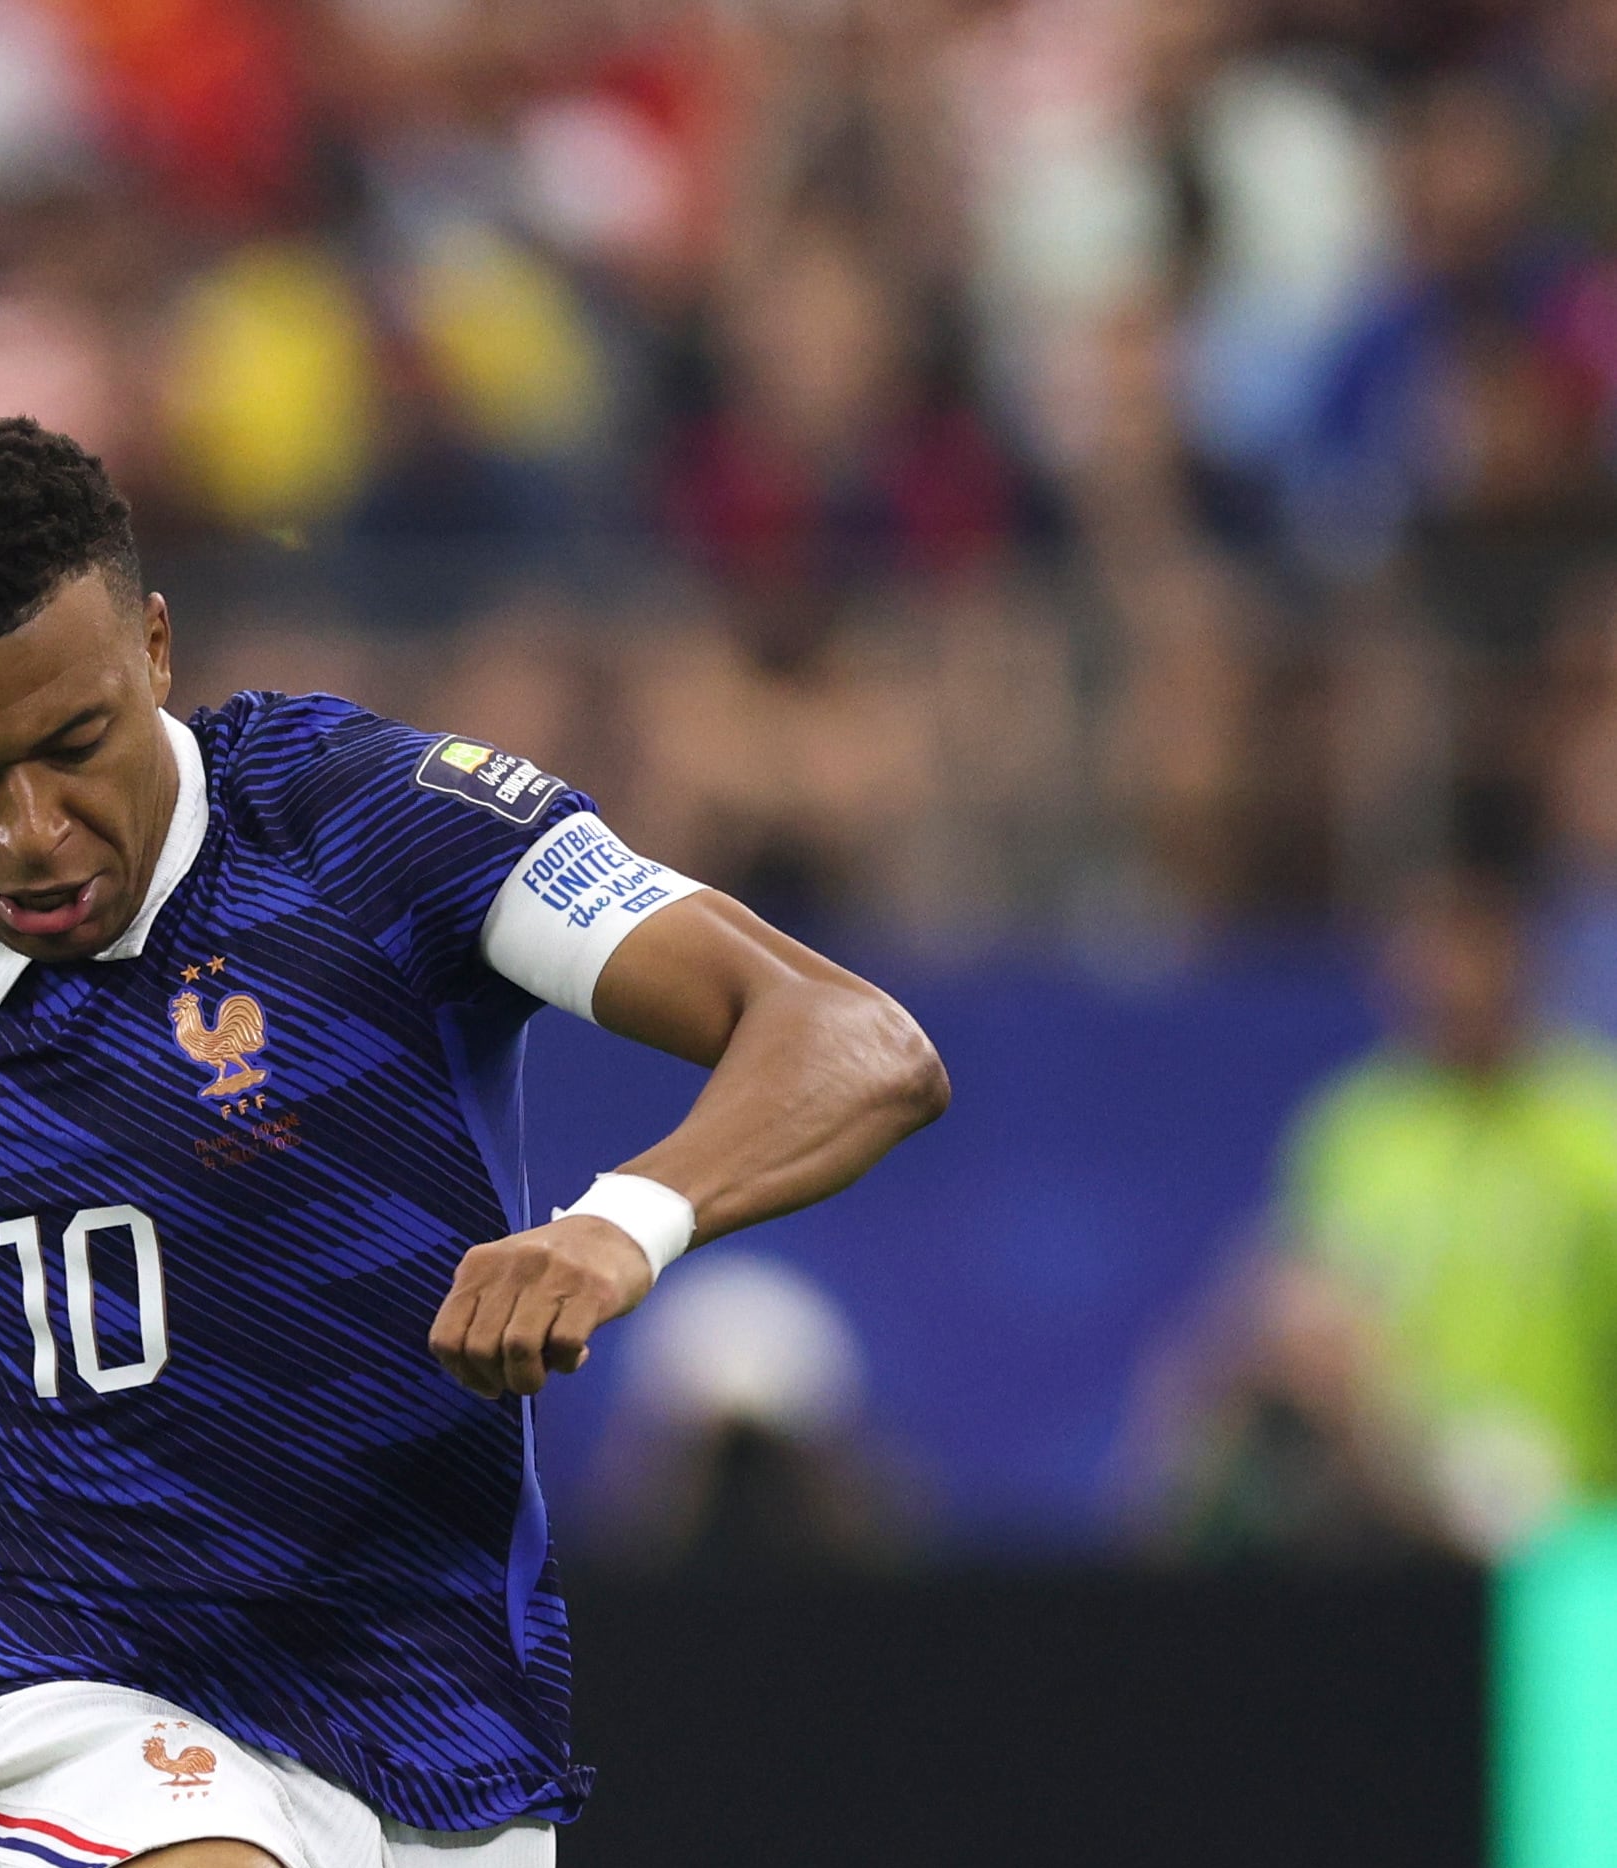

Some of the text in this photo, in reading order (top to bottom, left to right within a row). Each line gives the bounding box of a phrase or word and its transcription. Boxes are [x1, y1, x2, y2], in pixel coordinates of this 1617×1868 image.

[528, 778, 551, 796] FIFA
[522, 821, 609, 895] FOOTBALL
[541, 840, 633, 911] UNITES
[567, 861, 669, 928] the World
[625, 888, 668, 912] FIFA
